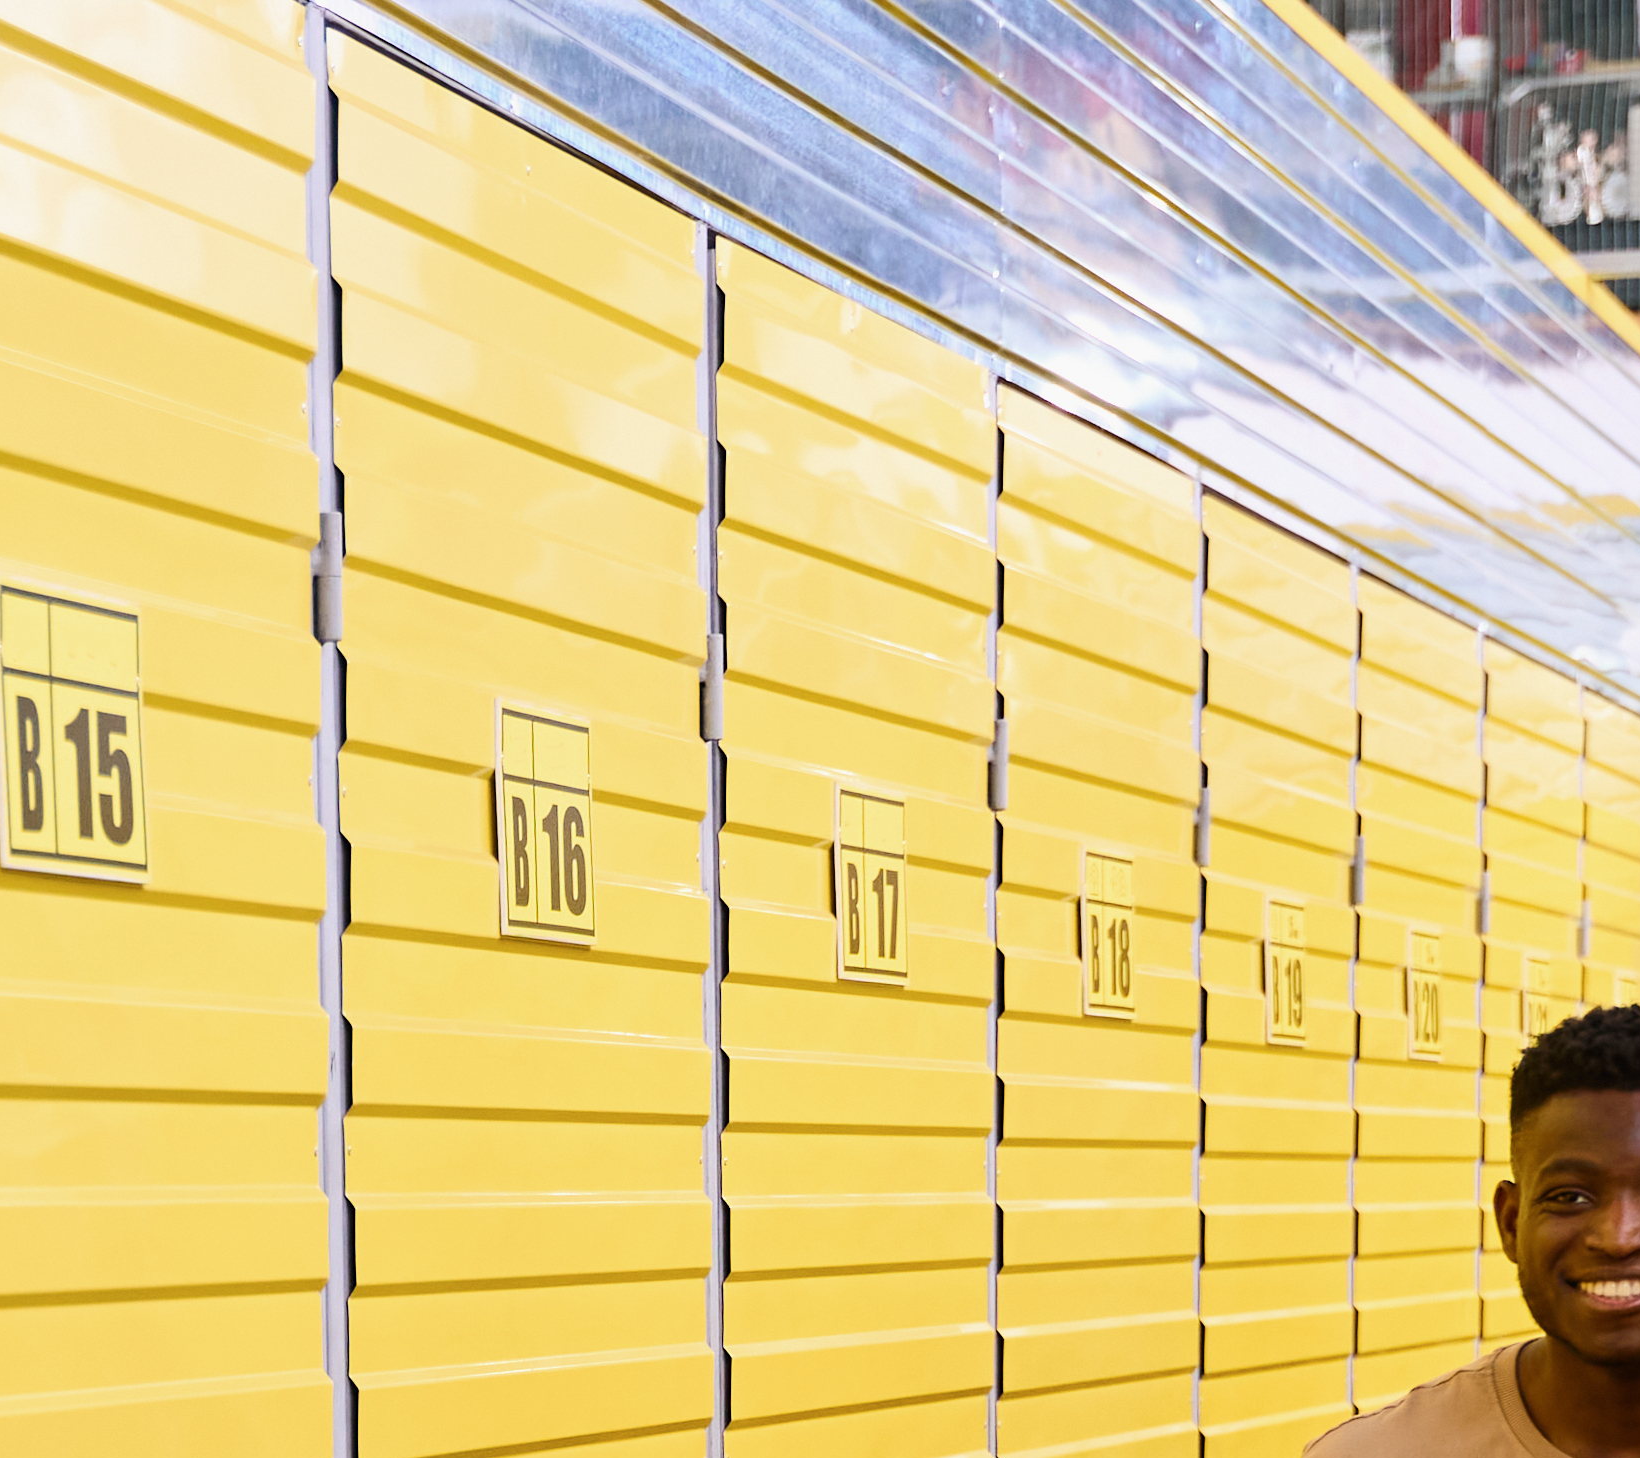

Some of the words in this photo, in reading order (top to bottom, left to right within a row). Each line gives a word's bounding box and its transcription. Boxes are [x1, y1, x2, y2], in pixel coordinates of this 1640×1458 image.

[16, 695, 44, 832] B
[64, 708, 134, 846] 15
[511, 795, 529, 907] B
[542, 804, 587, 916] 16
[847, 862, 860, 955] B
[872, 868, 899, 959] 17
[1091, 914, 1100, 993] B
[1107, 918, 1131, 998] 18
[1284, 958, 1302, 1028] 19
[1422, 981, 1438, 1043] 20
